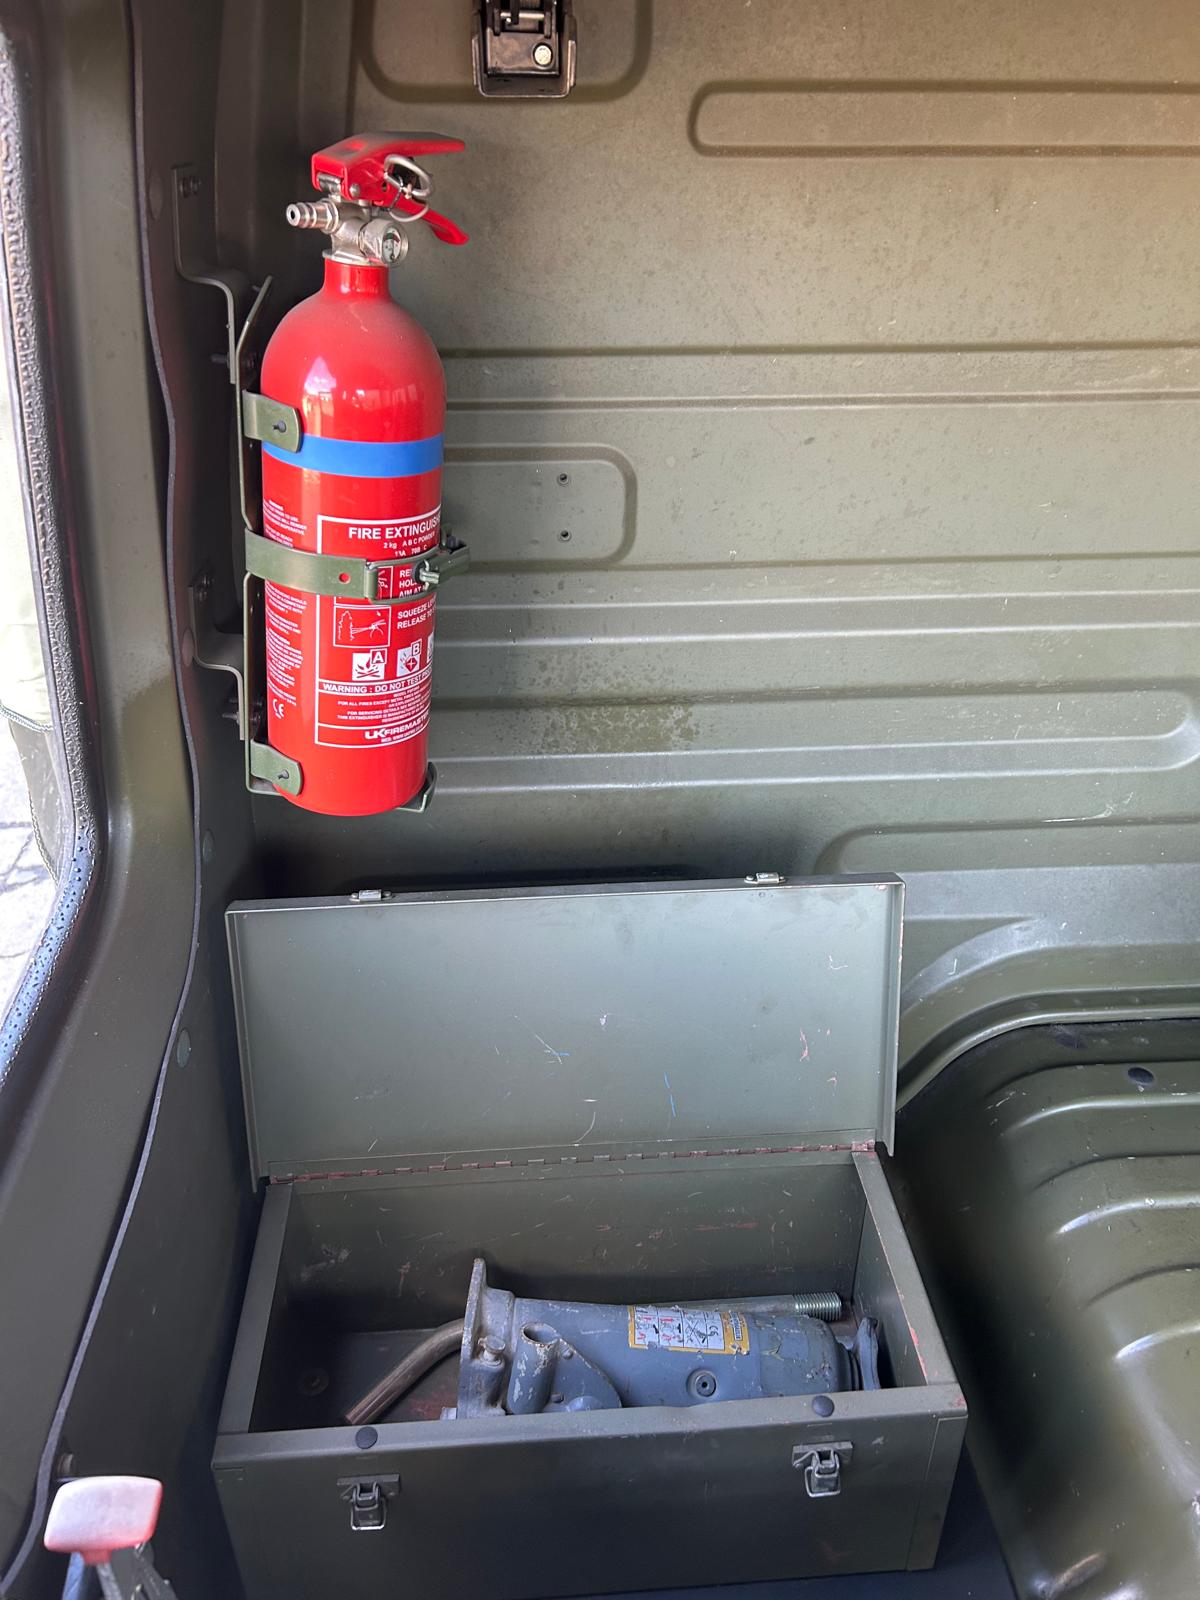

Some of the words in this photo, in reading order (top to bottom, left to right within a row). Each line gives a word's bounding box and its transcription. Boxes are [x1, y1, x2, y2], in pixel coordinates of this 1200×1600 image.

[348, 527, 381, 539] FIRE
[399, 578, 418, 589] HOL
[397, 602, 427, 619] SQUEEZE
[397, 613, 427, 629] RELEASE
[412, 641, 420, 655] B
[372, 651, 384, 664] A
[322, 683, 368, 694] WARNING
[374, 684, 388, 693] DO
[389, 680, 406, 691] NOT
[406, 675, 421, 687] TEST
